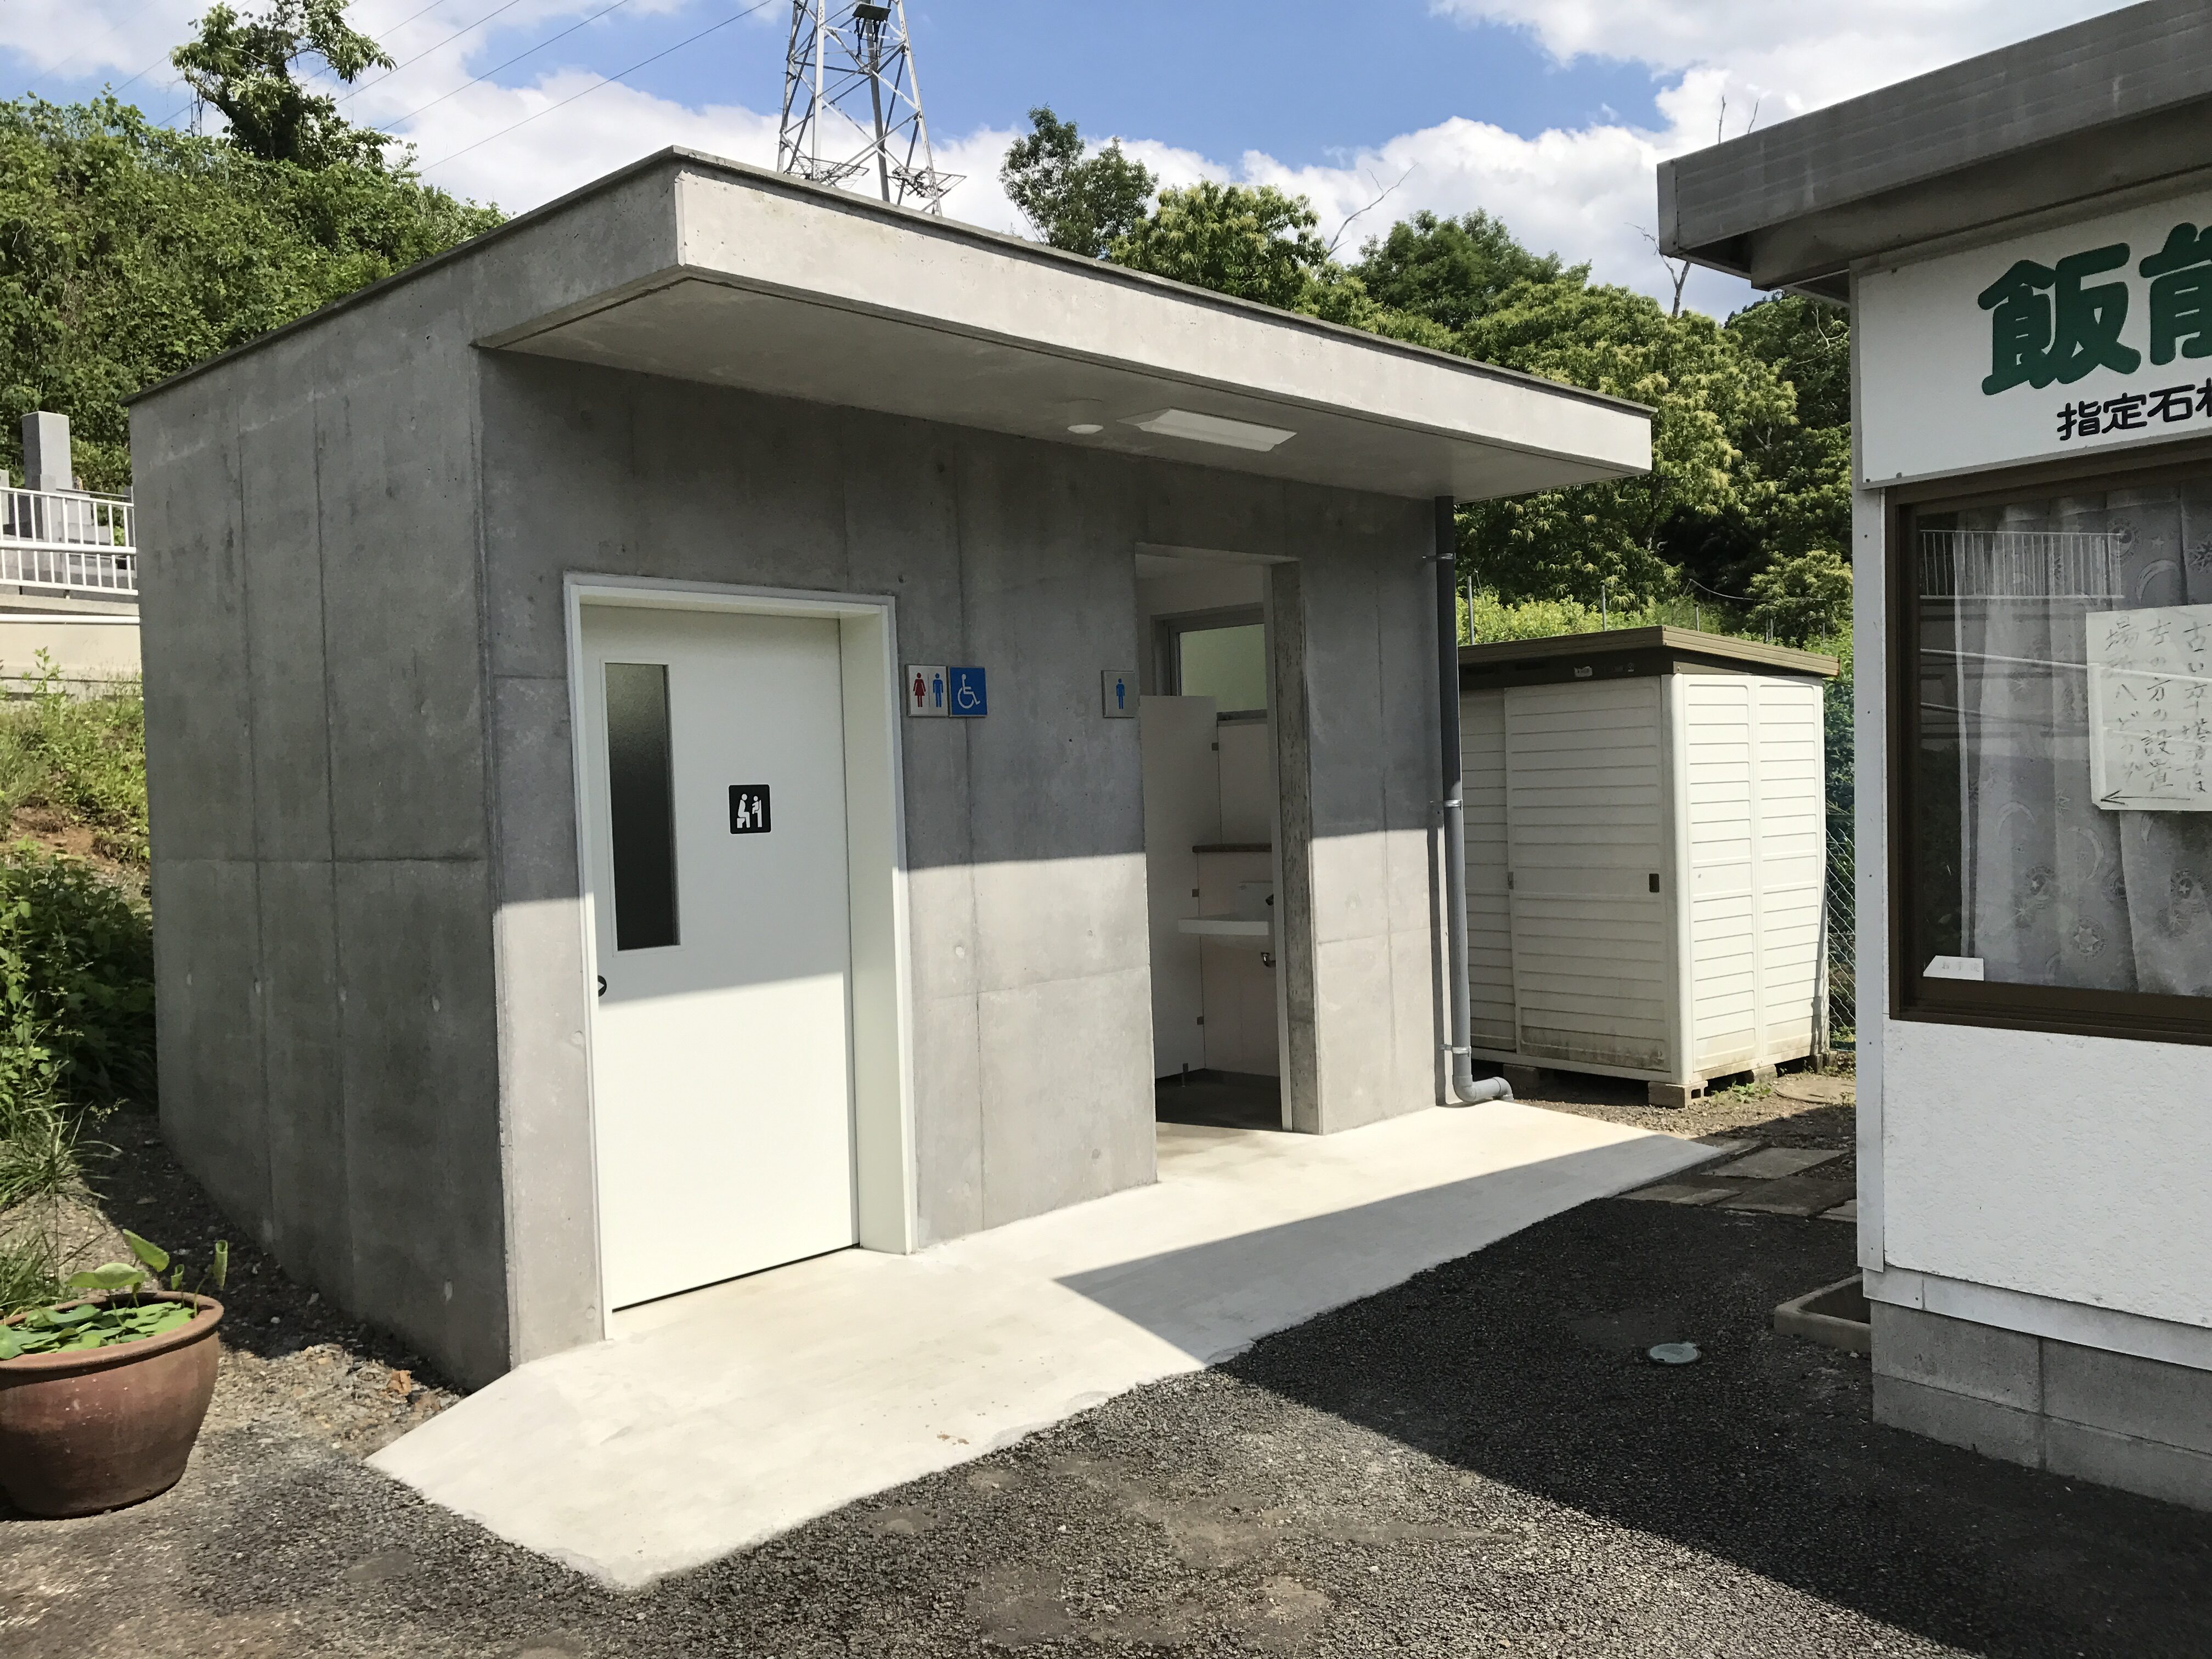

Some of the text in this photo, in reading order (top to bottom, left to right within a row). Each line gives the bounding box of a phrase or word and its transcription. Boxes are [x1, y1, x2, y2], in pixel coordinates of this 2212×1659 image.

[2141, 618, 2175, 792] 左の方の設置
